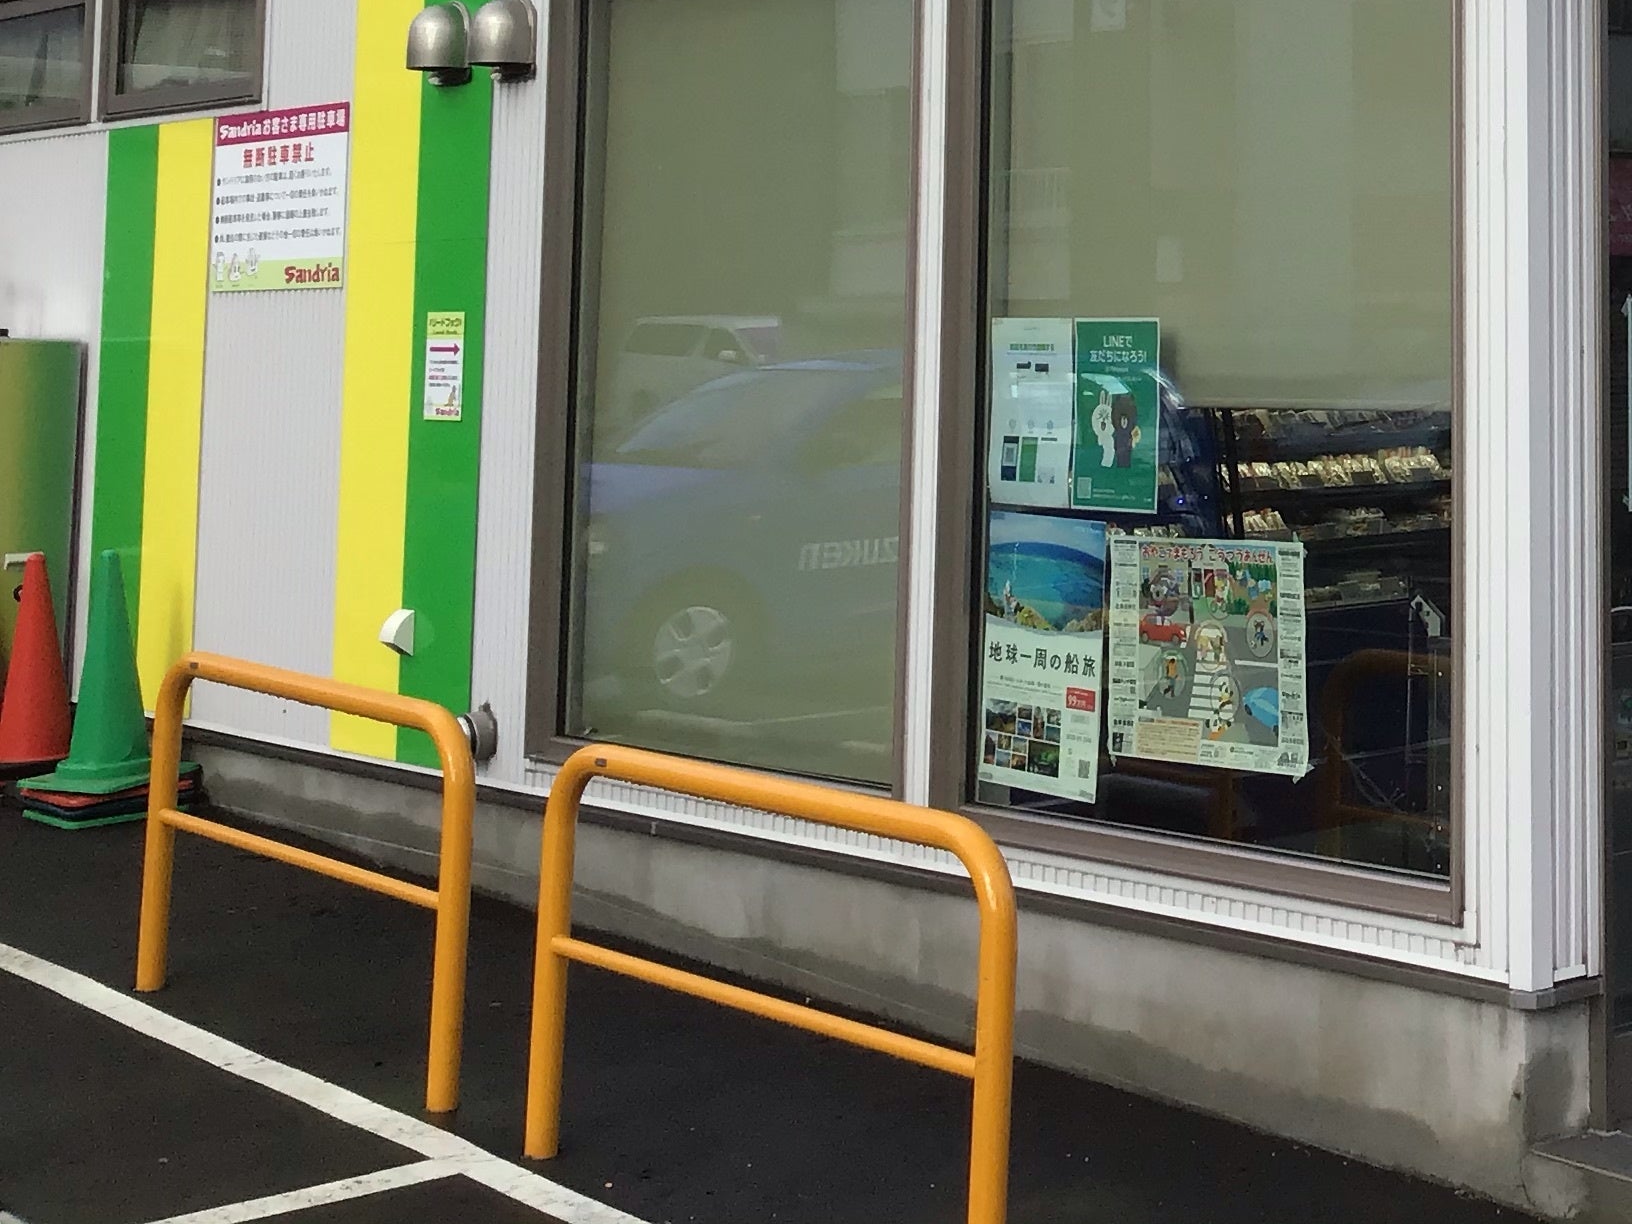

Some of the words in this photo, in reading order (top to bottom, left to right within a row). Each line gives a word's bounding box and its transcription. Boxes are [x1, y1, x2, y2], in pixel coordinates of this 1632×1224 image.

[243, 142, 315, 168] 無断駐車禁止
[284, 262, 340, 284] Sandria
[1103, 335, 1133, 347] LINEで
[989, 640, 1096, 678] 地球一周の船旅
